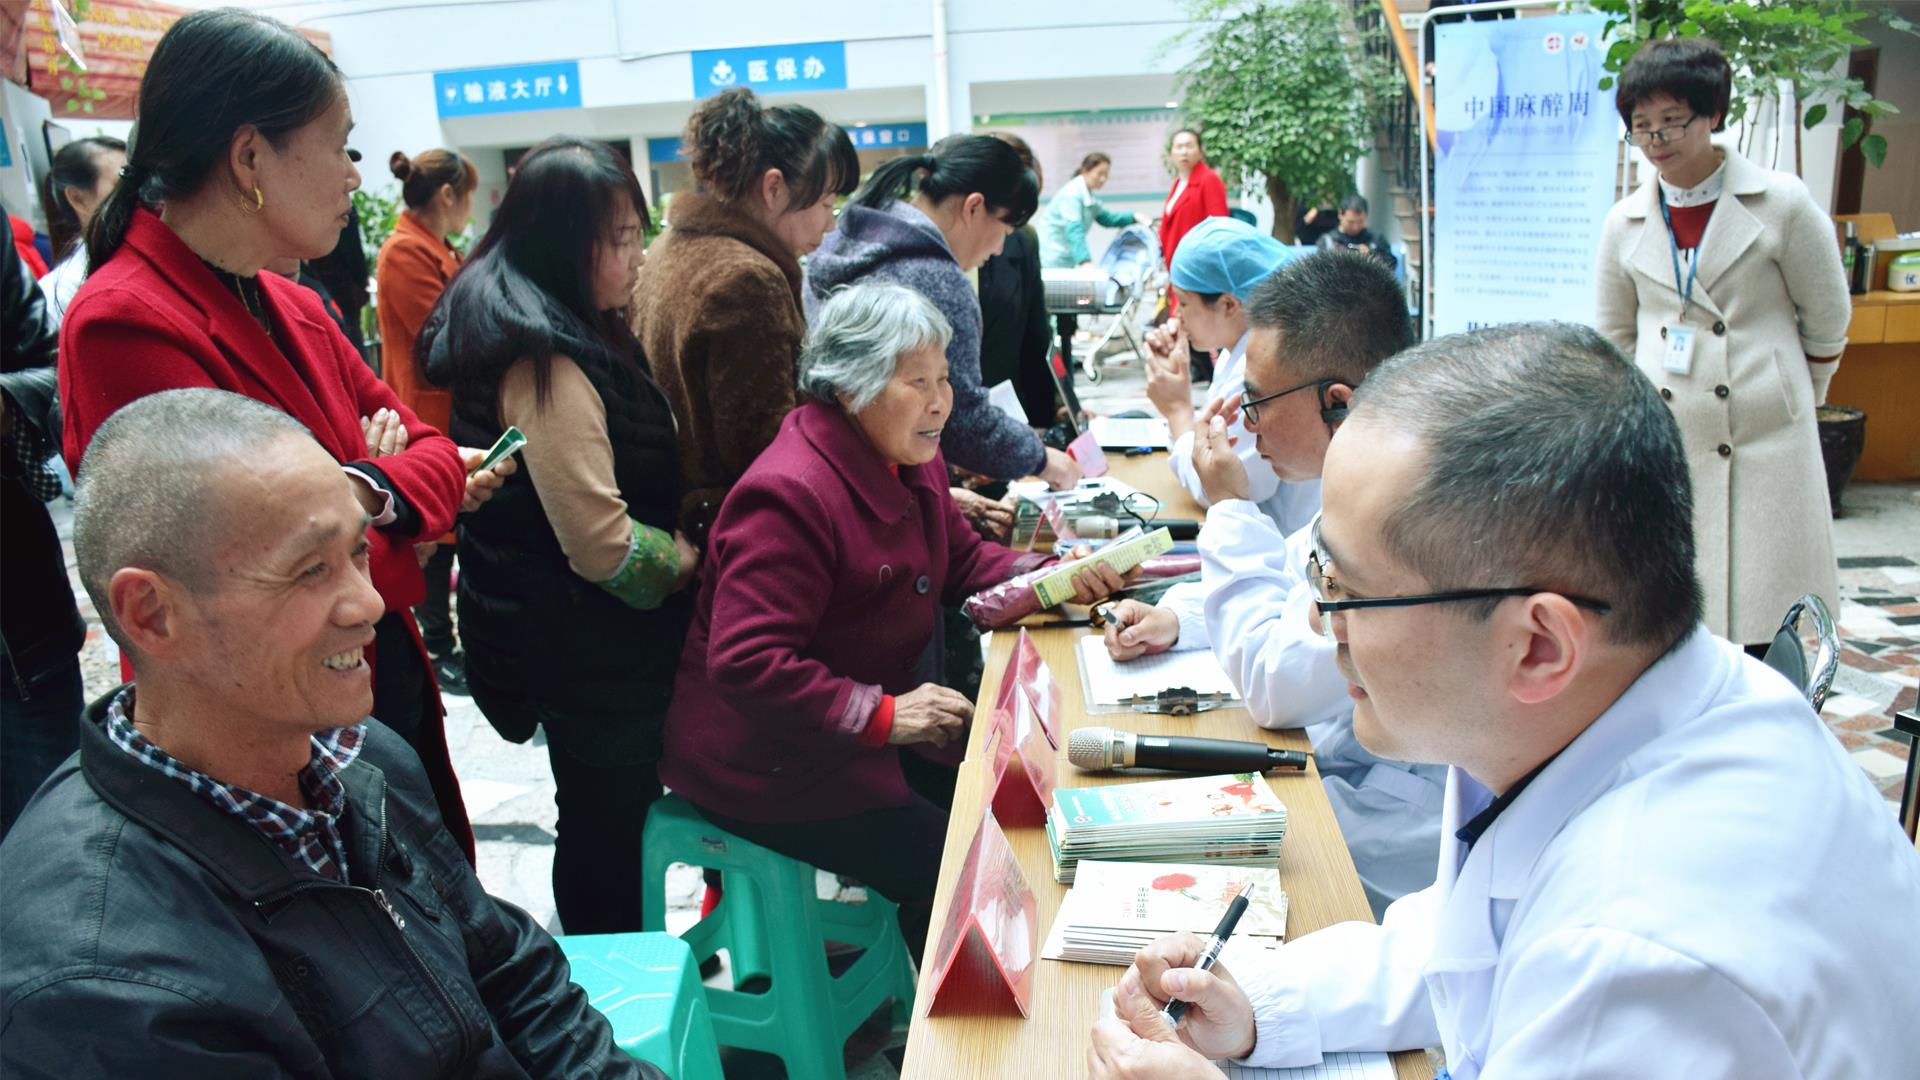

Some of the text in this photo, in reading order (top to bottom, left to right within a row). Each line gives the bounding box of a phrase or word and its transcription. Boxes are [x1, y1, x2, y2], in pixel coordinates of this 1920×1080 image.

[748, 55, 826, 82] 医保办
[463, 76, 553, 104] 输液大厅
[1464, 91, 1590, 120] 中国麻醉周
